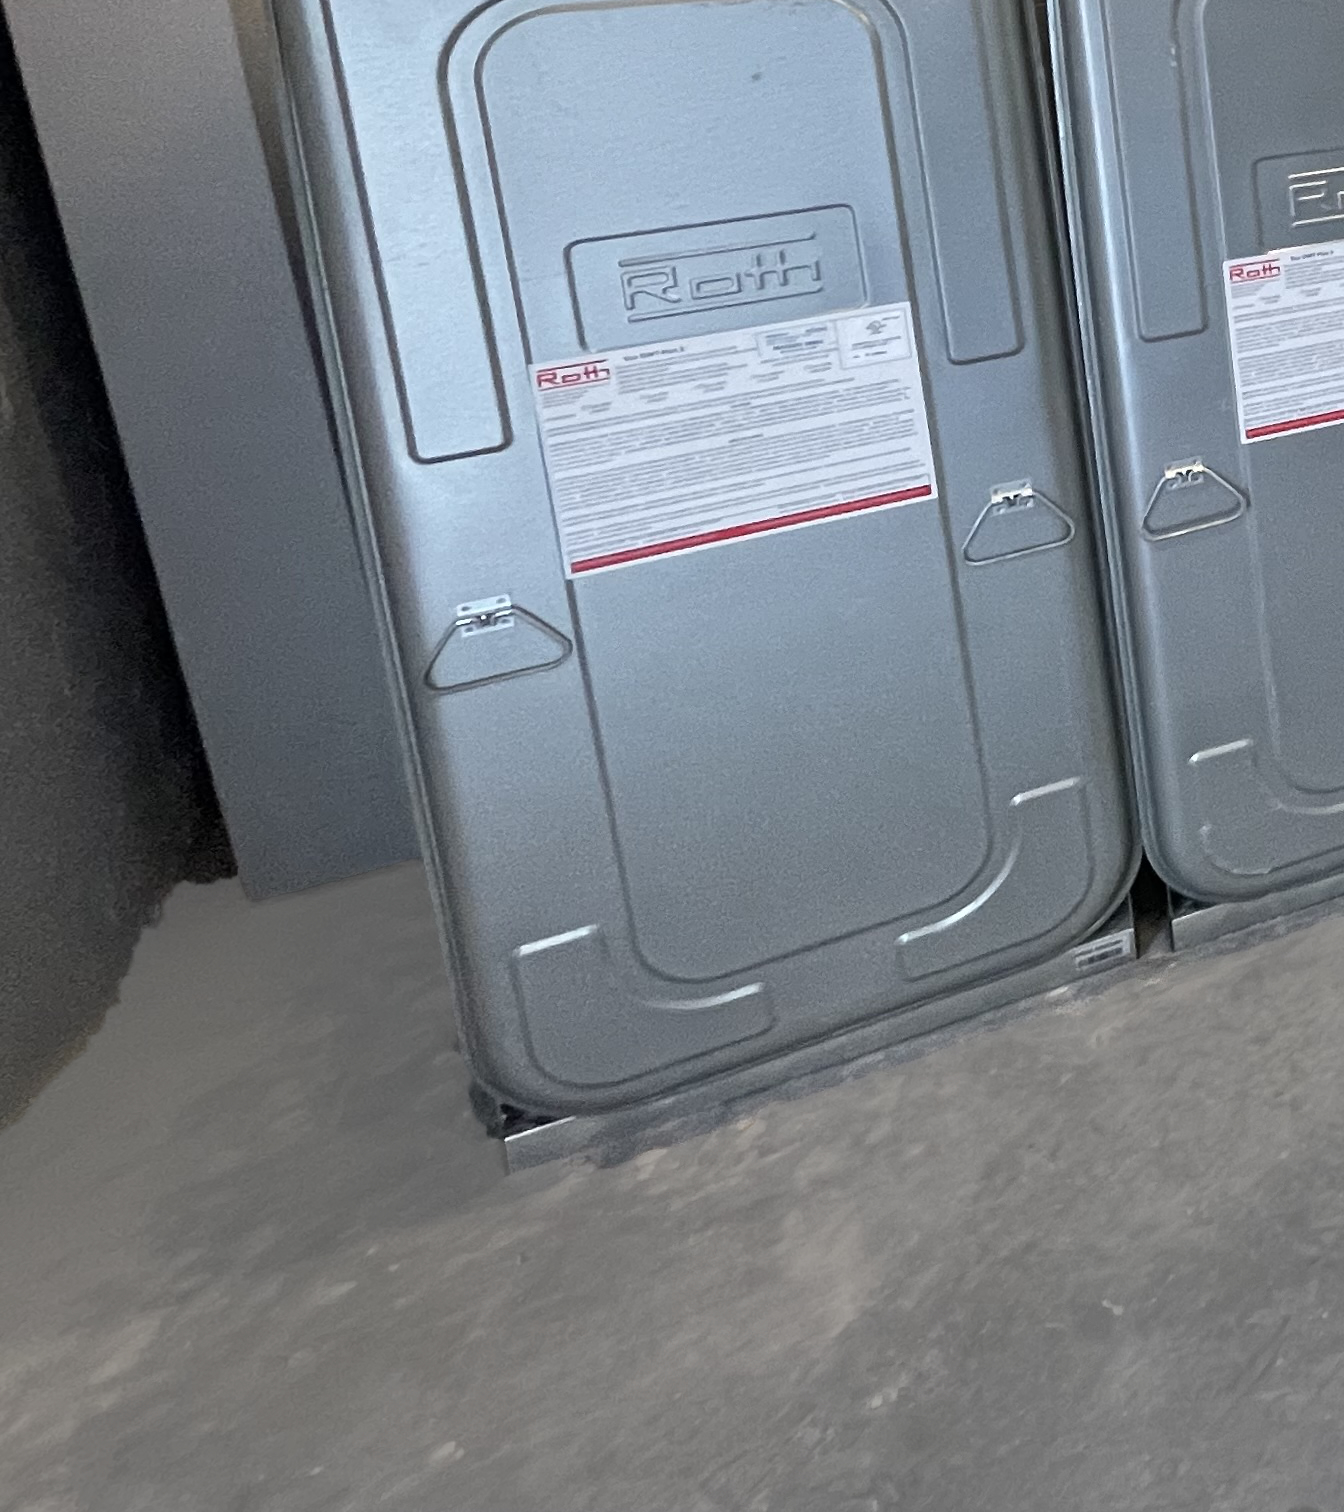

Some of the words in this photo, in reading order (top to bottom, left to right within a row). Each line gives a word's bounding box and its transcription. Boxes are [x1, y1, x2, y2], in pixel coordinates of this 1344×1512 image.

[618, 248, 822, 312] Roth
[1229, 262, 1281, 282] Roth
[536, 365, 611, 388] Roth
